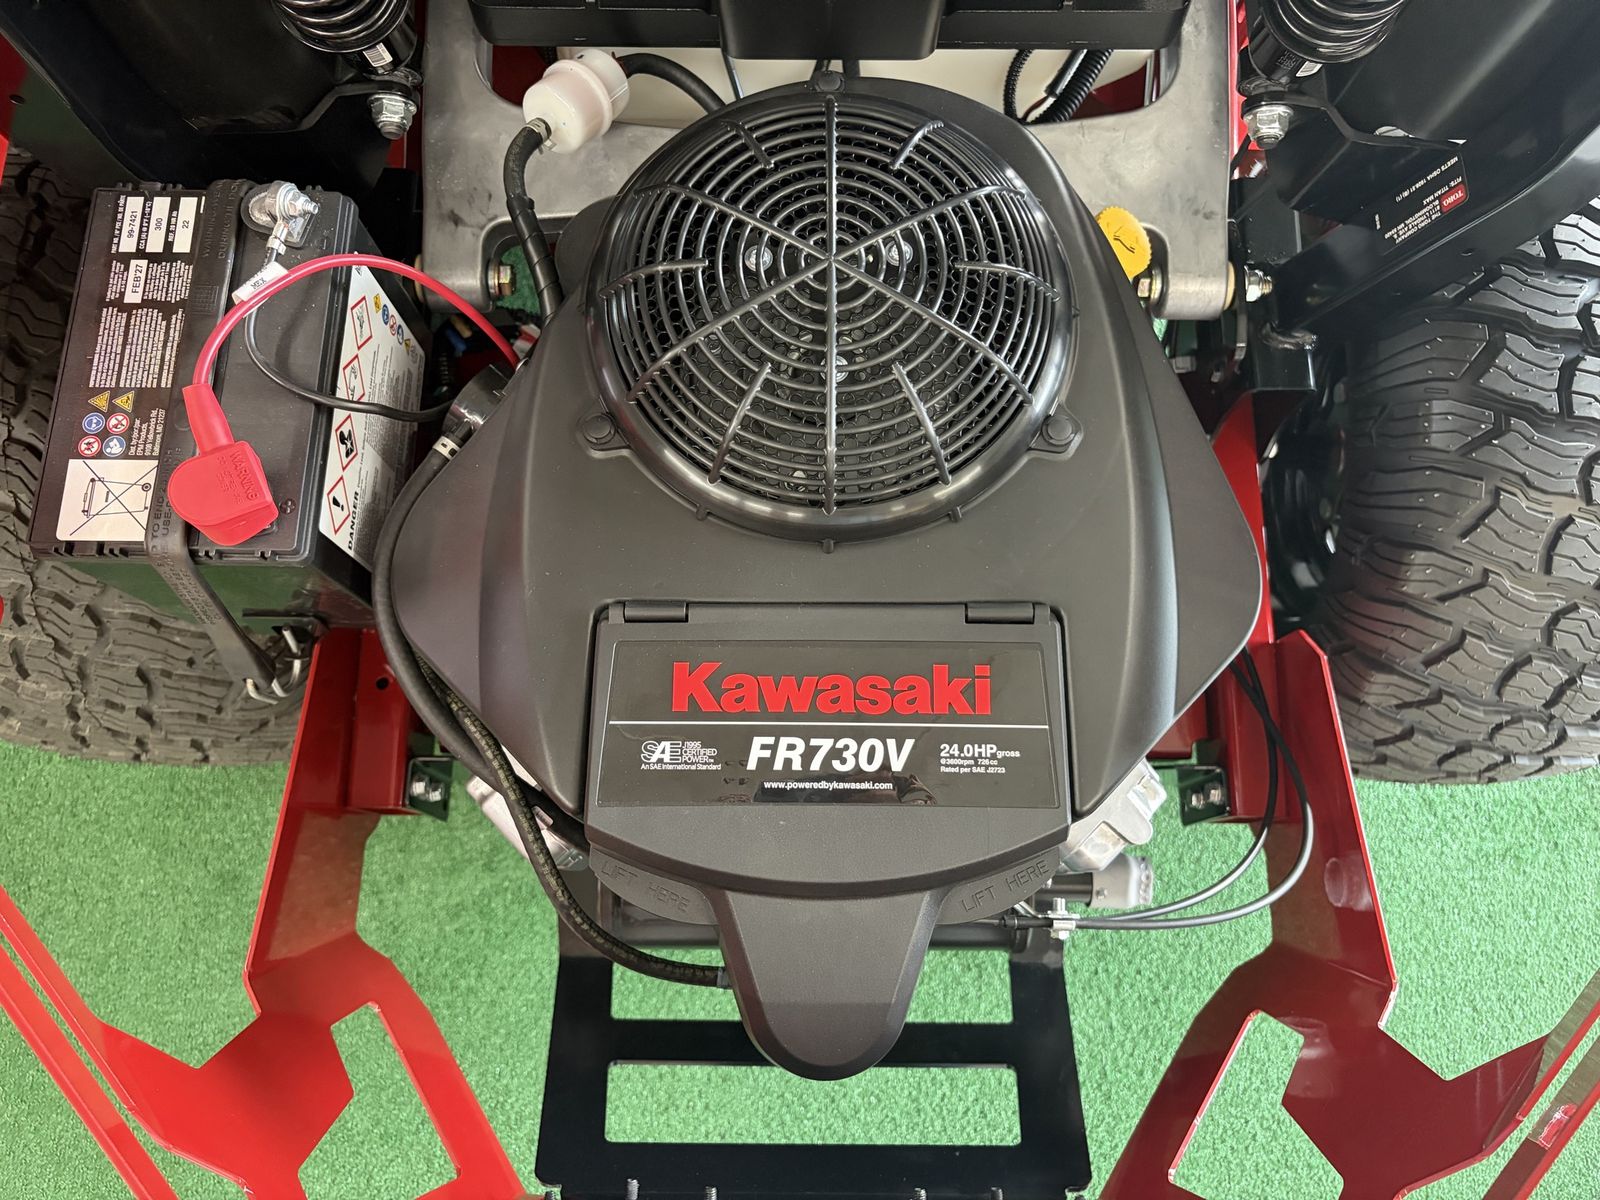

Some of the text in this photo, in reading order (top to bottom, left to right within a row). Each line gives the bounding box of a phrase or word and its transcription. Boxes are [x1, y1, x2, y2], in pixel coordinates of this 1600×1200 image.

[1422, 194, 1434, 206] MAX
[1443, 190, 1464, 206] TORO
[127, 210, 138, 238] 99-7421
[154, 218, 163, 231] 300
[182, 220, 190, 229] 22
[132, 264, 144, 294] FEB'27
[156, 423, 162, 432] MD
[229, 450, 260, 500] WARNING
[348, 491, 360, 551] DANGER
[672, 661, 991, 715] Kawasaki
[640, 741, 682, 763] SAE
[746, 736, 915, 772] FR730V
[764, 780, 893, 790] www.poweredbykawasaki.com
[601, 860, 690, 913] LIFT HERE
[961, 860, 1049, 912] LIFT HERE
